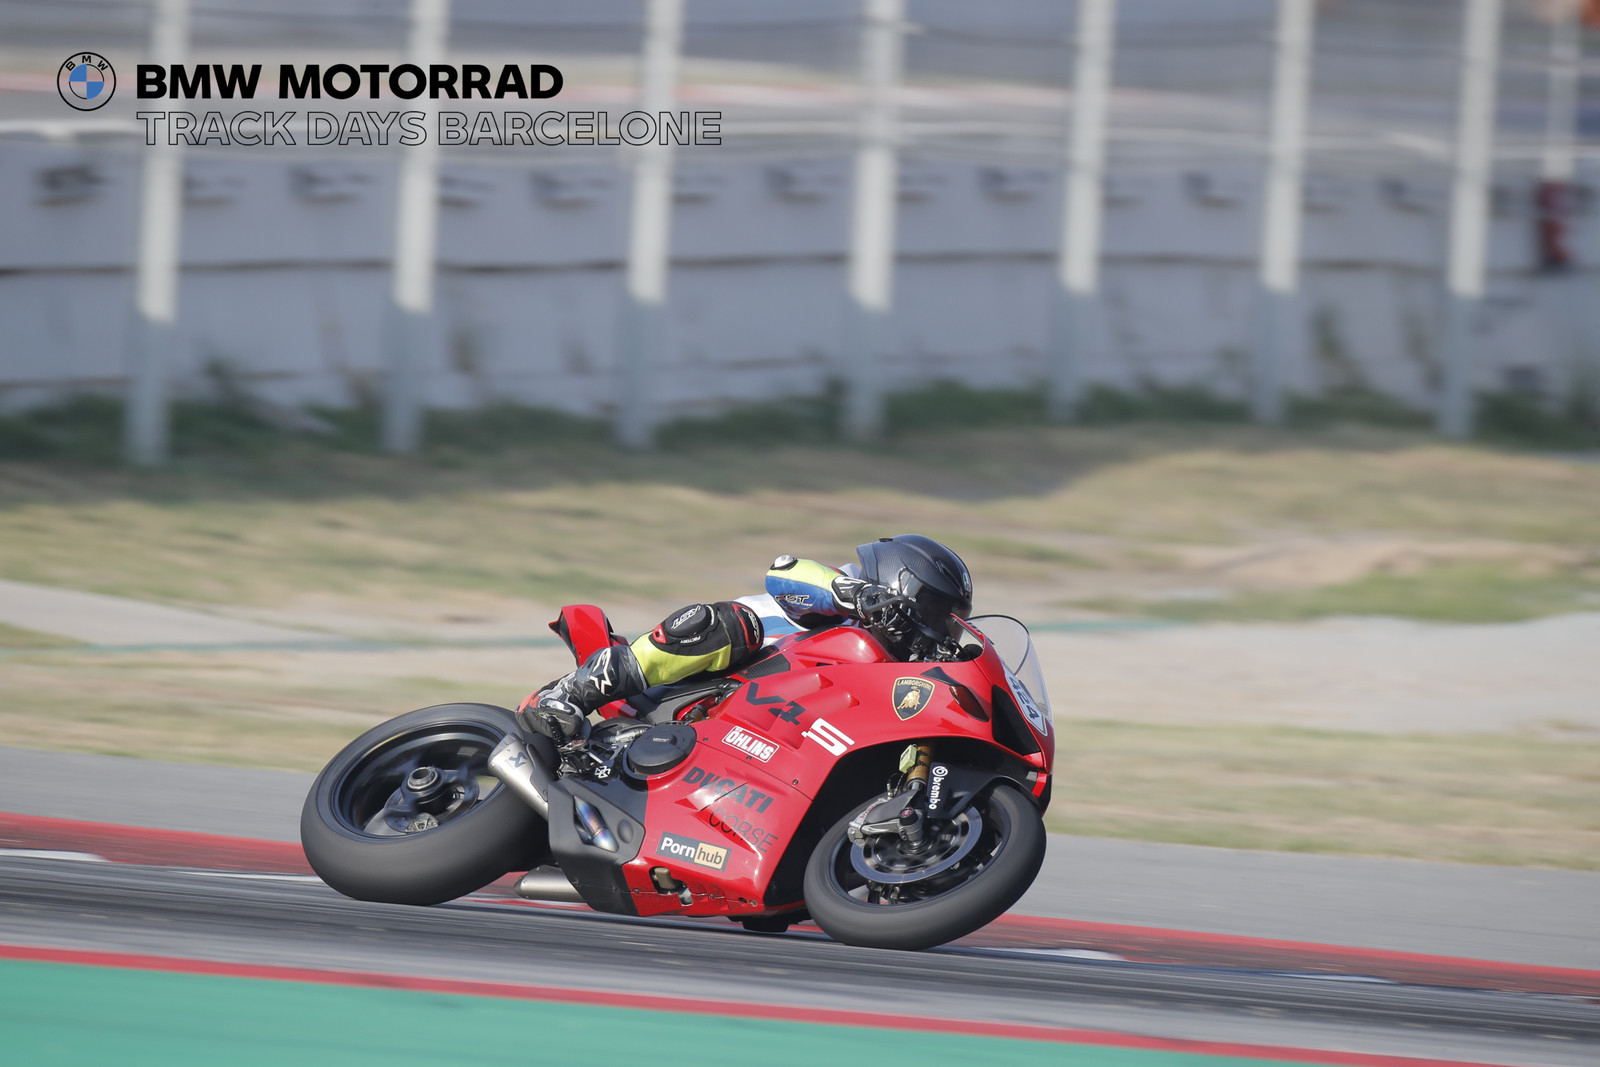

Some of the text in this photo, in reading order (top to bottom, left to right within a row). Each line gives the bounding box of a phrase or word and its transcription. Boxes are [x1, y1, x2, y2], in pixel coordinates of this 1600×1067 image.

[727, 727, 775, 761] ÖHLINS
[682, 766, 774, 814] DUCATI
[929, 777, 945, 810] brembo
[709, 808, 778, 853] CORSE
